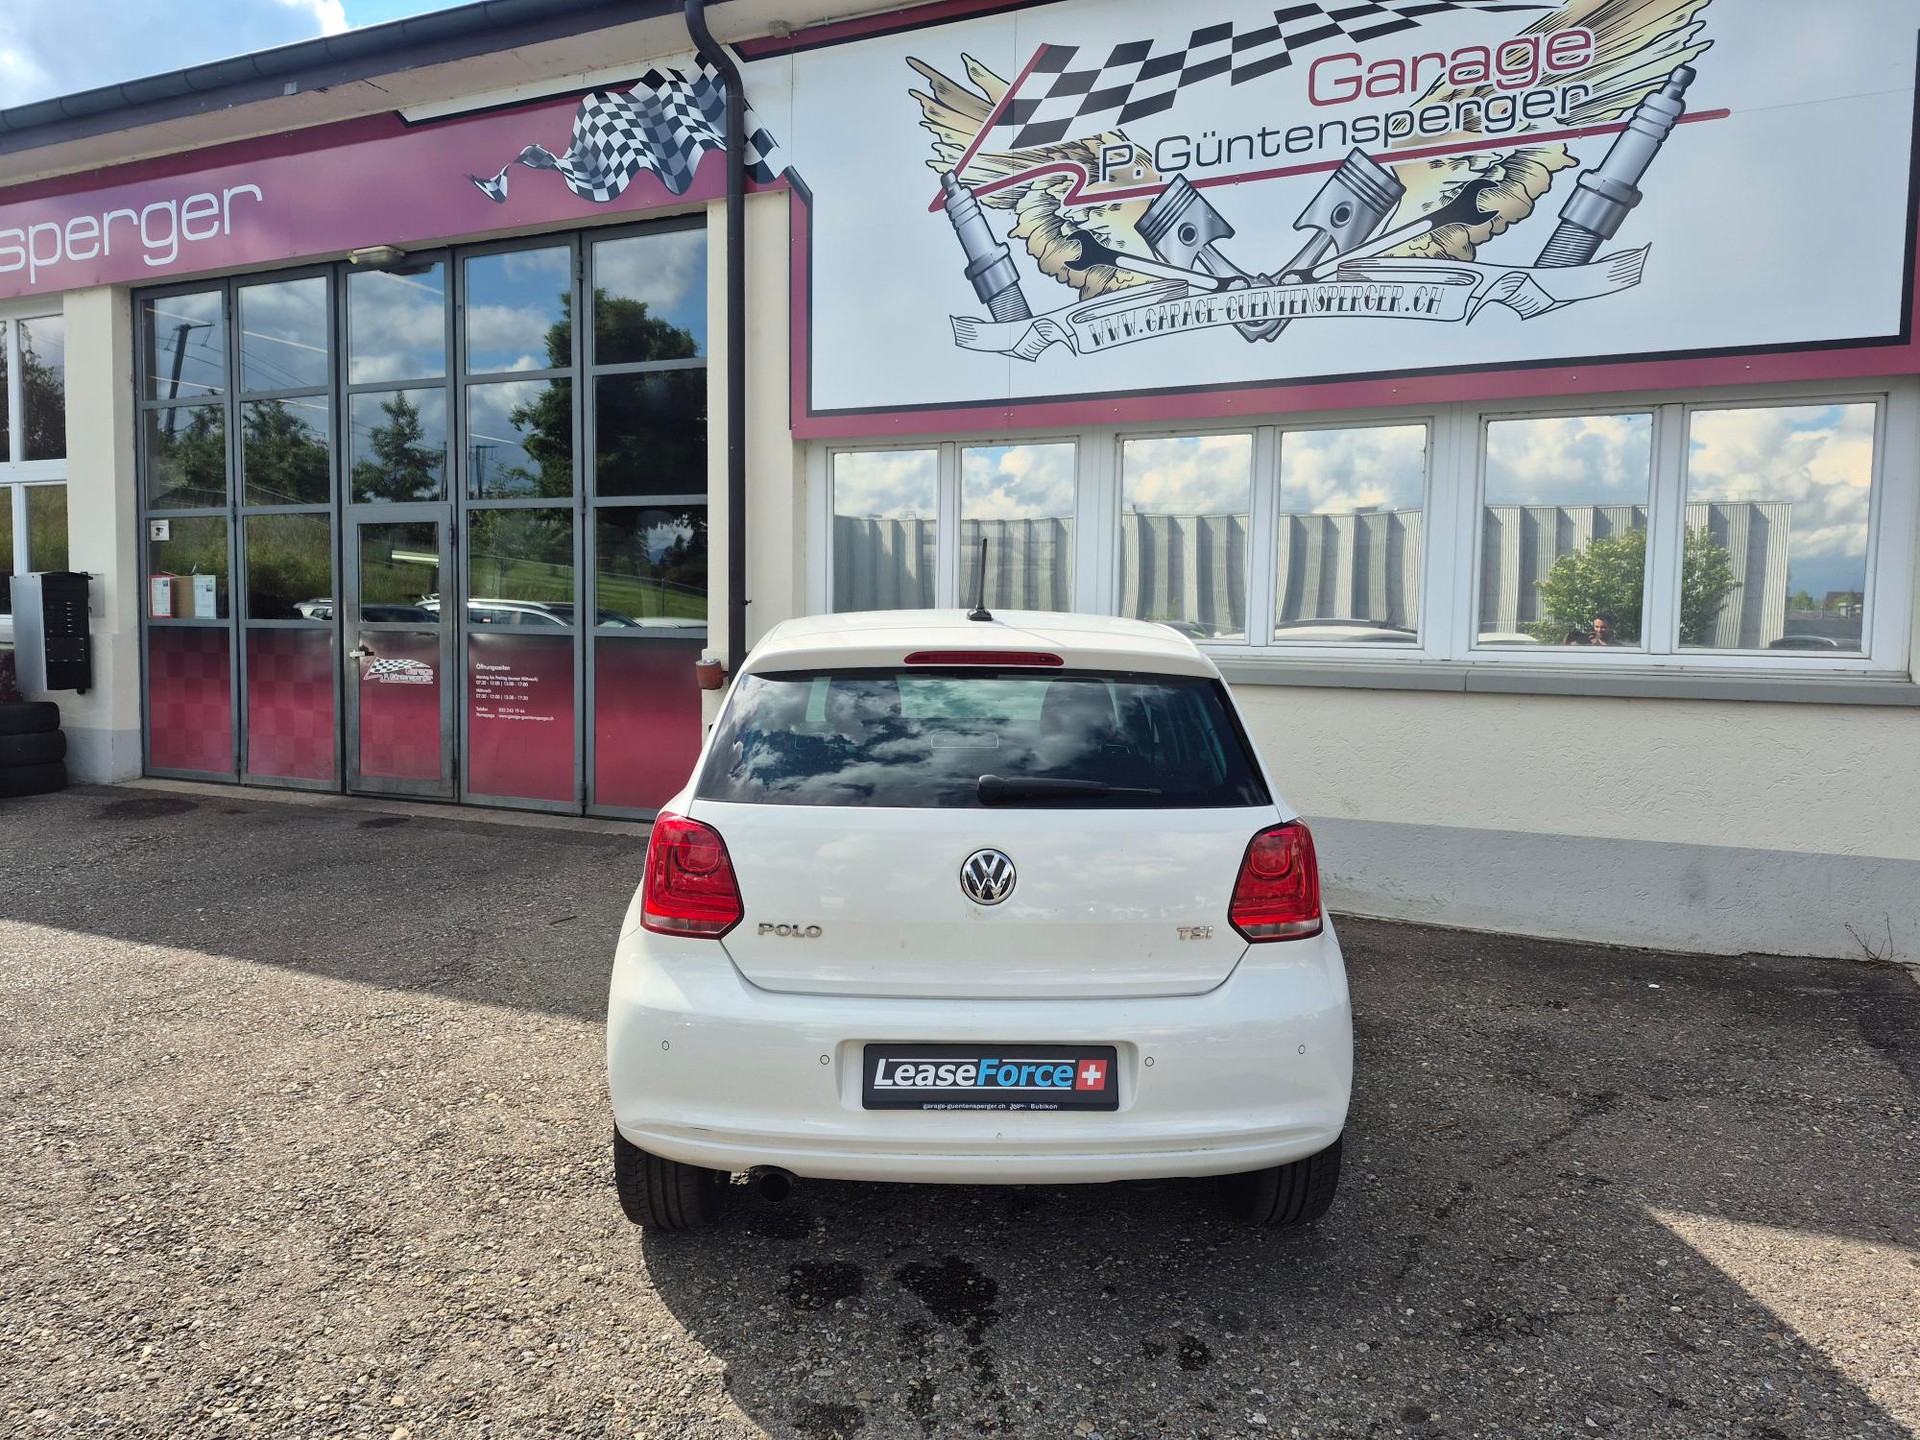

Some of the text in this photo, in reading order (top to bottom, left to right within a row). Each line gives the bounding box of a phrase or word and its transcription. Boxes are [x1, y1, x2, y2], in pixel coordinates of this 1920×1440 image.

[1307, 27, 1592, 107] Garage
[1101, 83, 1590, 182] P. Güntensperger
[1088, 285, 1445, 347] WWW.GARAGE-GUENTENSPERGER.CH
[757, 922, 823, 939] POLO
[1175, 925, 1214, 942] TSI
[873, 1058, 1074, 1087] LeaseForce
